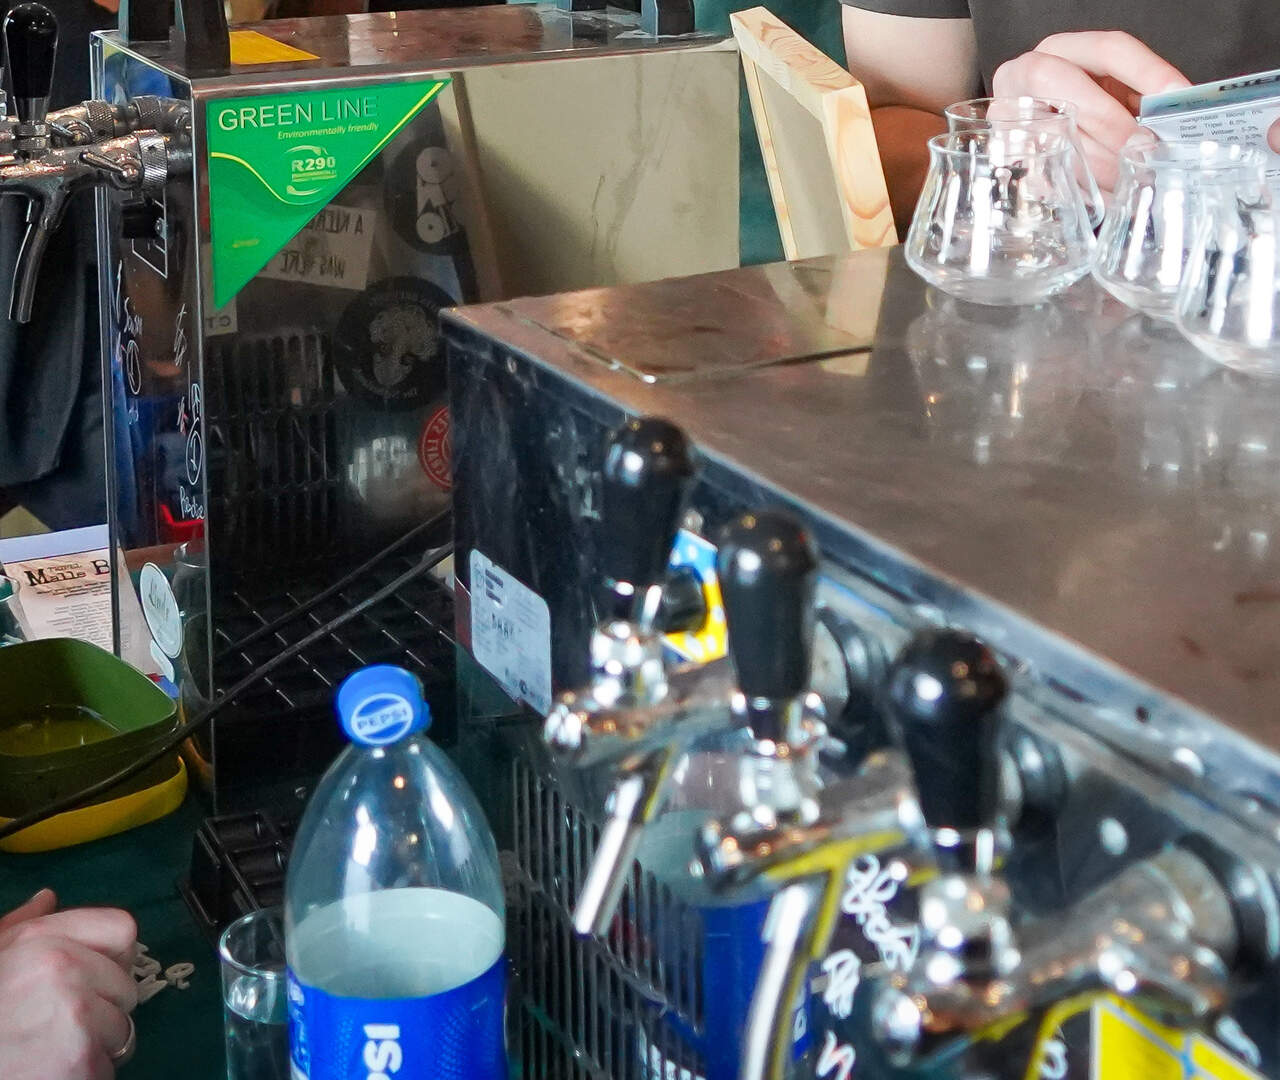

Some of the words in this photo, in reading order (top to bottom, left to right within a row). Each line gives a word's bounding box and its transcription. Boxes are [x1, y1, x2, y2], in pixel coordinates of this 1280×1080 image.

[218, 102, 313, 131] GREEN
[321, 95, 379, 121] LINE
[277, 124, 347, 140] Environmentally
[347, 121, 379, 134] friendly
[291, 157, 336, 172] R290
[23, 568, 87, 587] Malle
[90, 559, 110, 576] B
[357, 707, 408, 731] PEPSI
